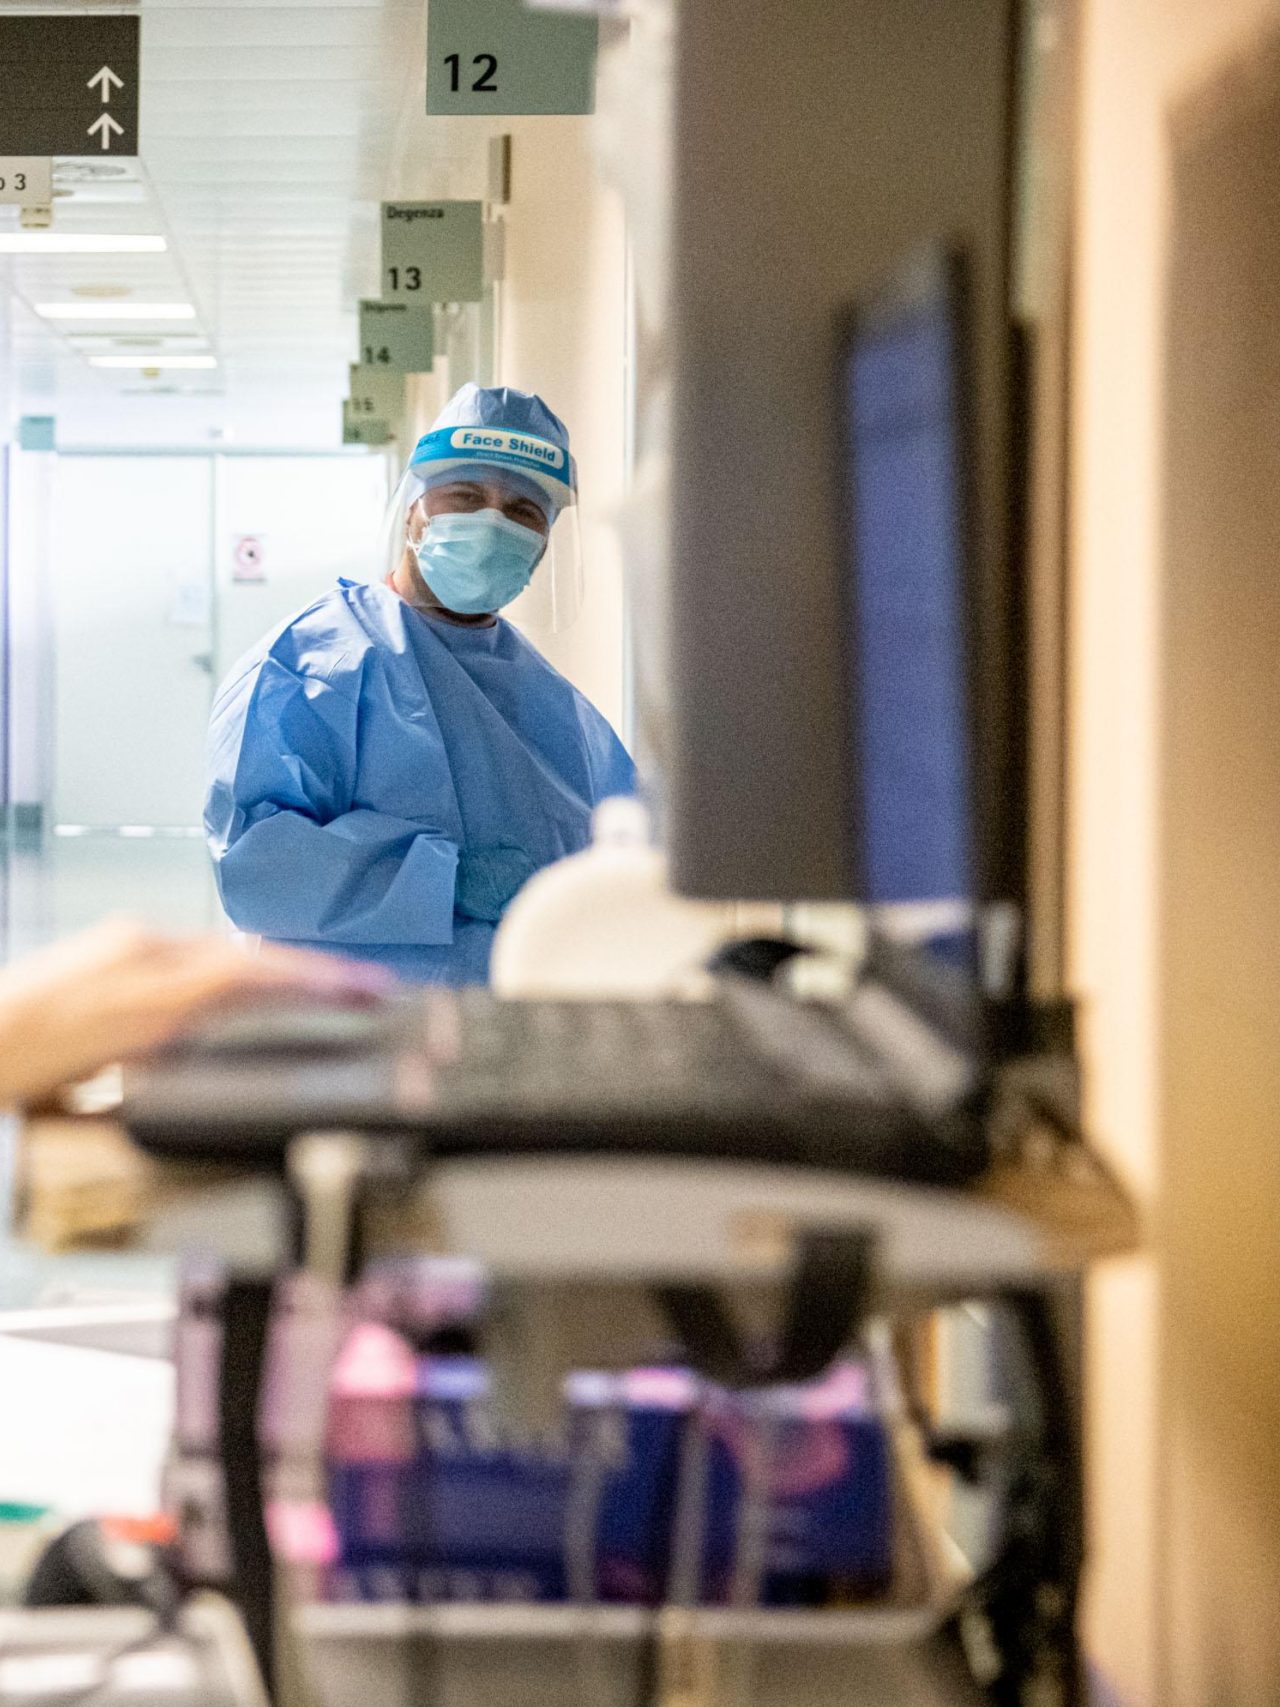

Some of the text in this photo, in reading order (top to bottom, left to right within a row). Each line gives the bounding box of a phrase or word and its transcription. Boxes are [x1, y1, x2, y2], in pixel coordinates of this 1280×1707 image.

[444, 53, 499, 93] 12
[15, 173, 27, 192] 3
[386, 206, 445, 221] Degenza
[389, 267, 422, 292] 13
[366, 347, 391, 365] 14
[463, 433, 503, 447] Face
[508, 438, 556, 463] Shield
